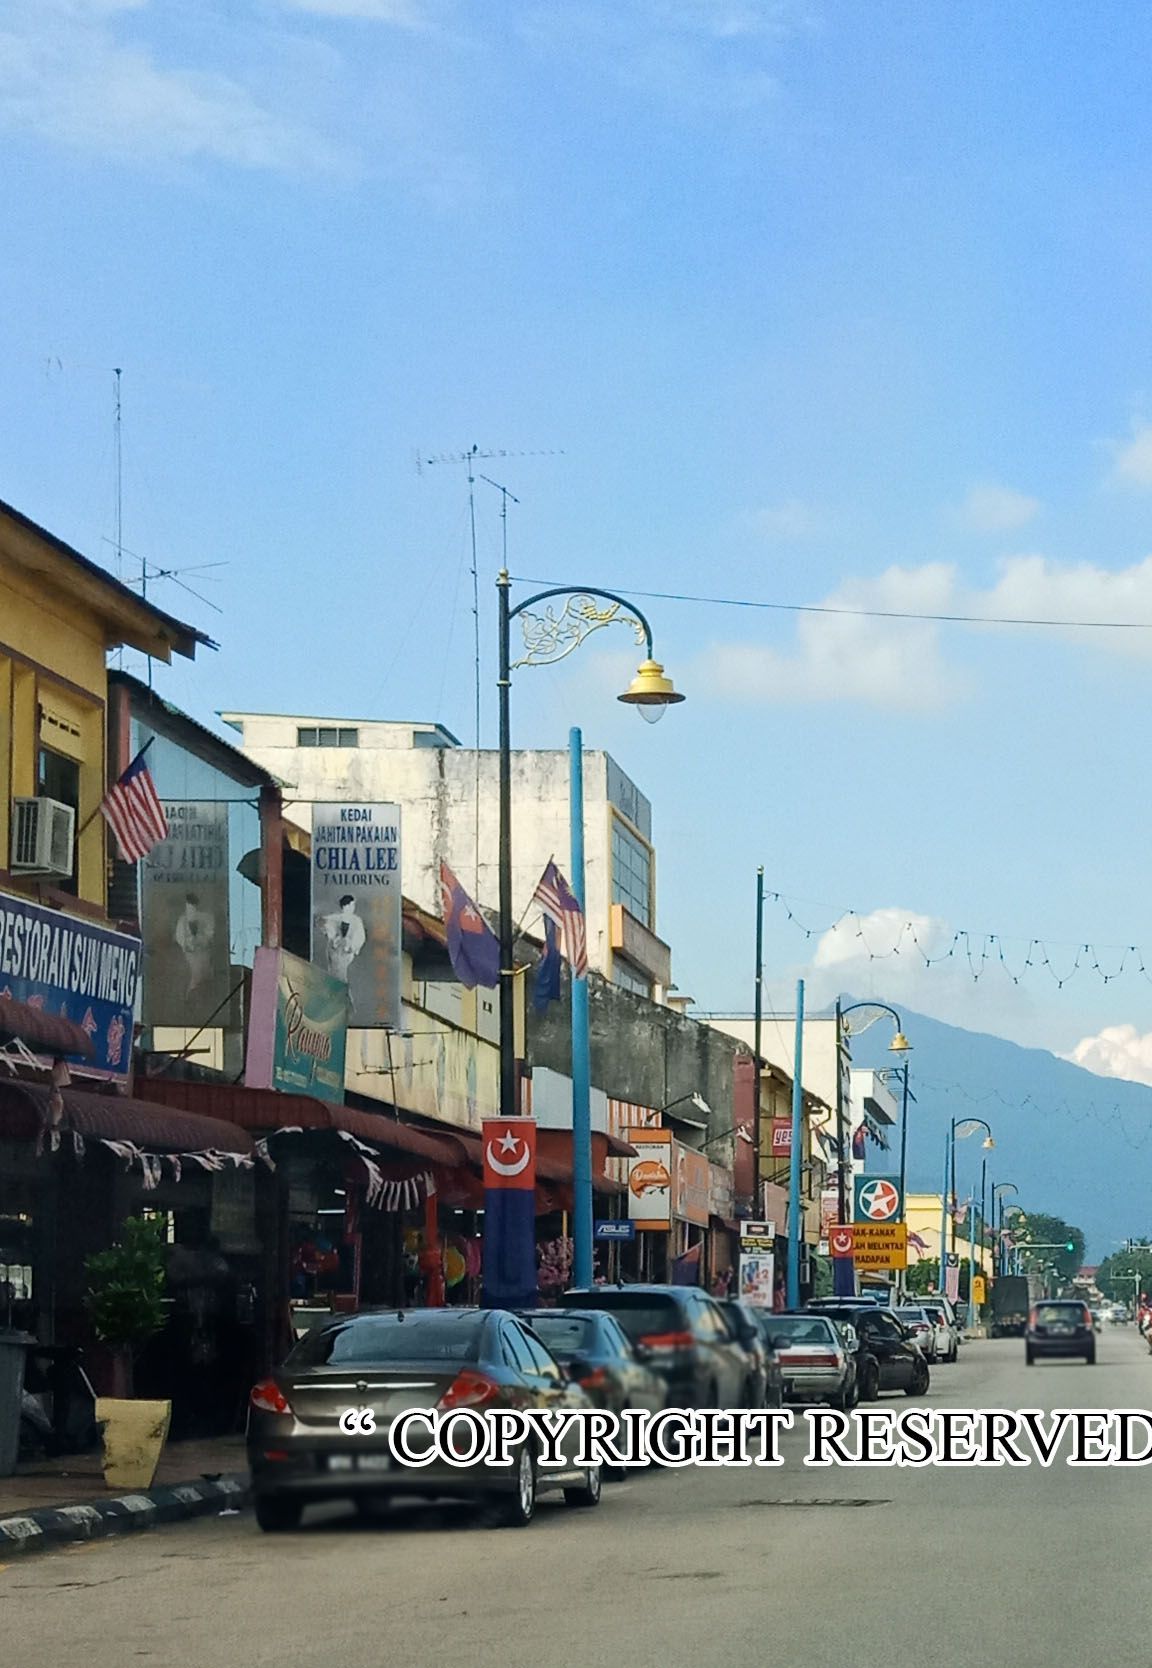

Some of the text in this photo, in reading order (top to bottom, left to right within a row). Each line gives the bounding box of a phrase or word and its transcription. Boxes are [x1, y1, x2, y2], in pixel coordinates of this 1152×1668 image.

[340, 808, 372, 822] KEDAI
[315, 826, 397, 843] JAHITAN PAKAIAN
[316, 847, 398, 871] CHIA LEE
[323, 873, 390, 886] TAILORING
[71, 933, 101, 998] SUN
[97, 941, 136, 1007] MENG
[855, 1255, 891, 1264] HADAPAN
